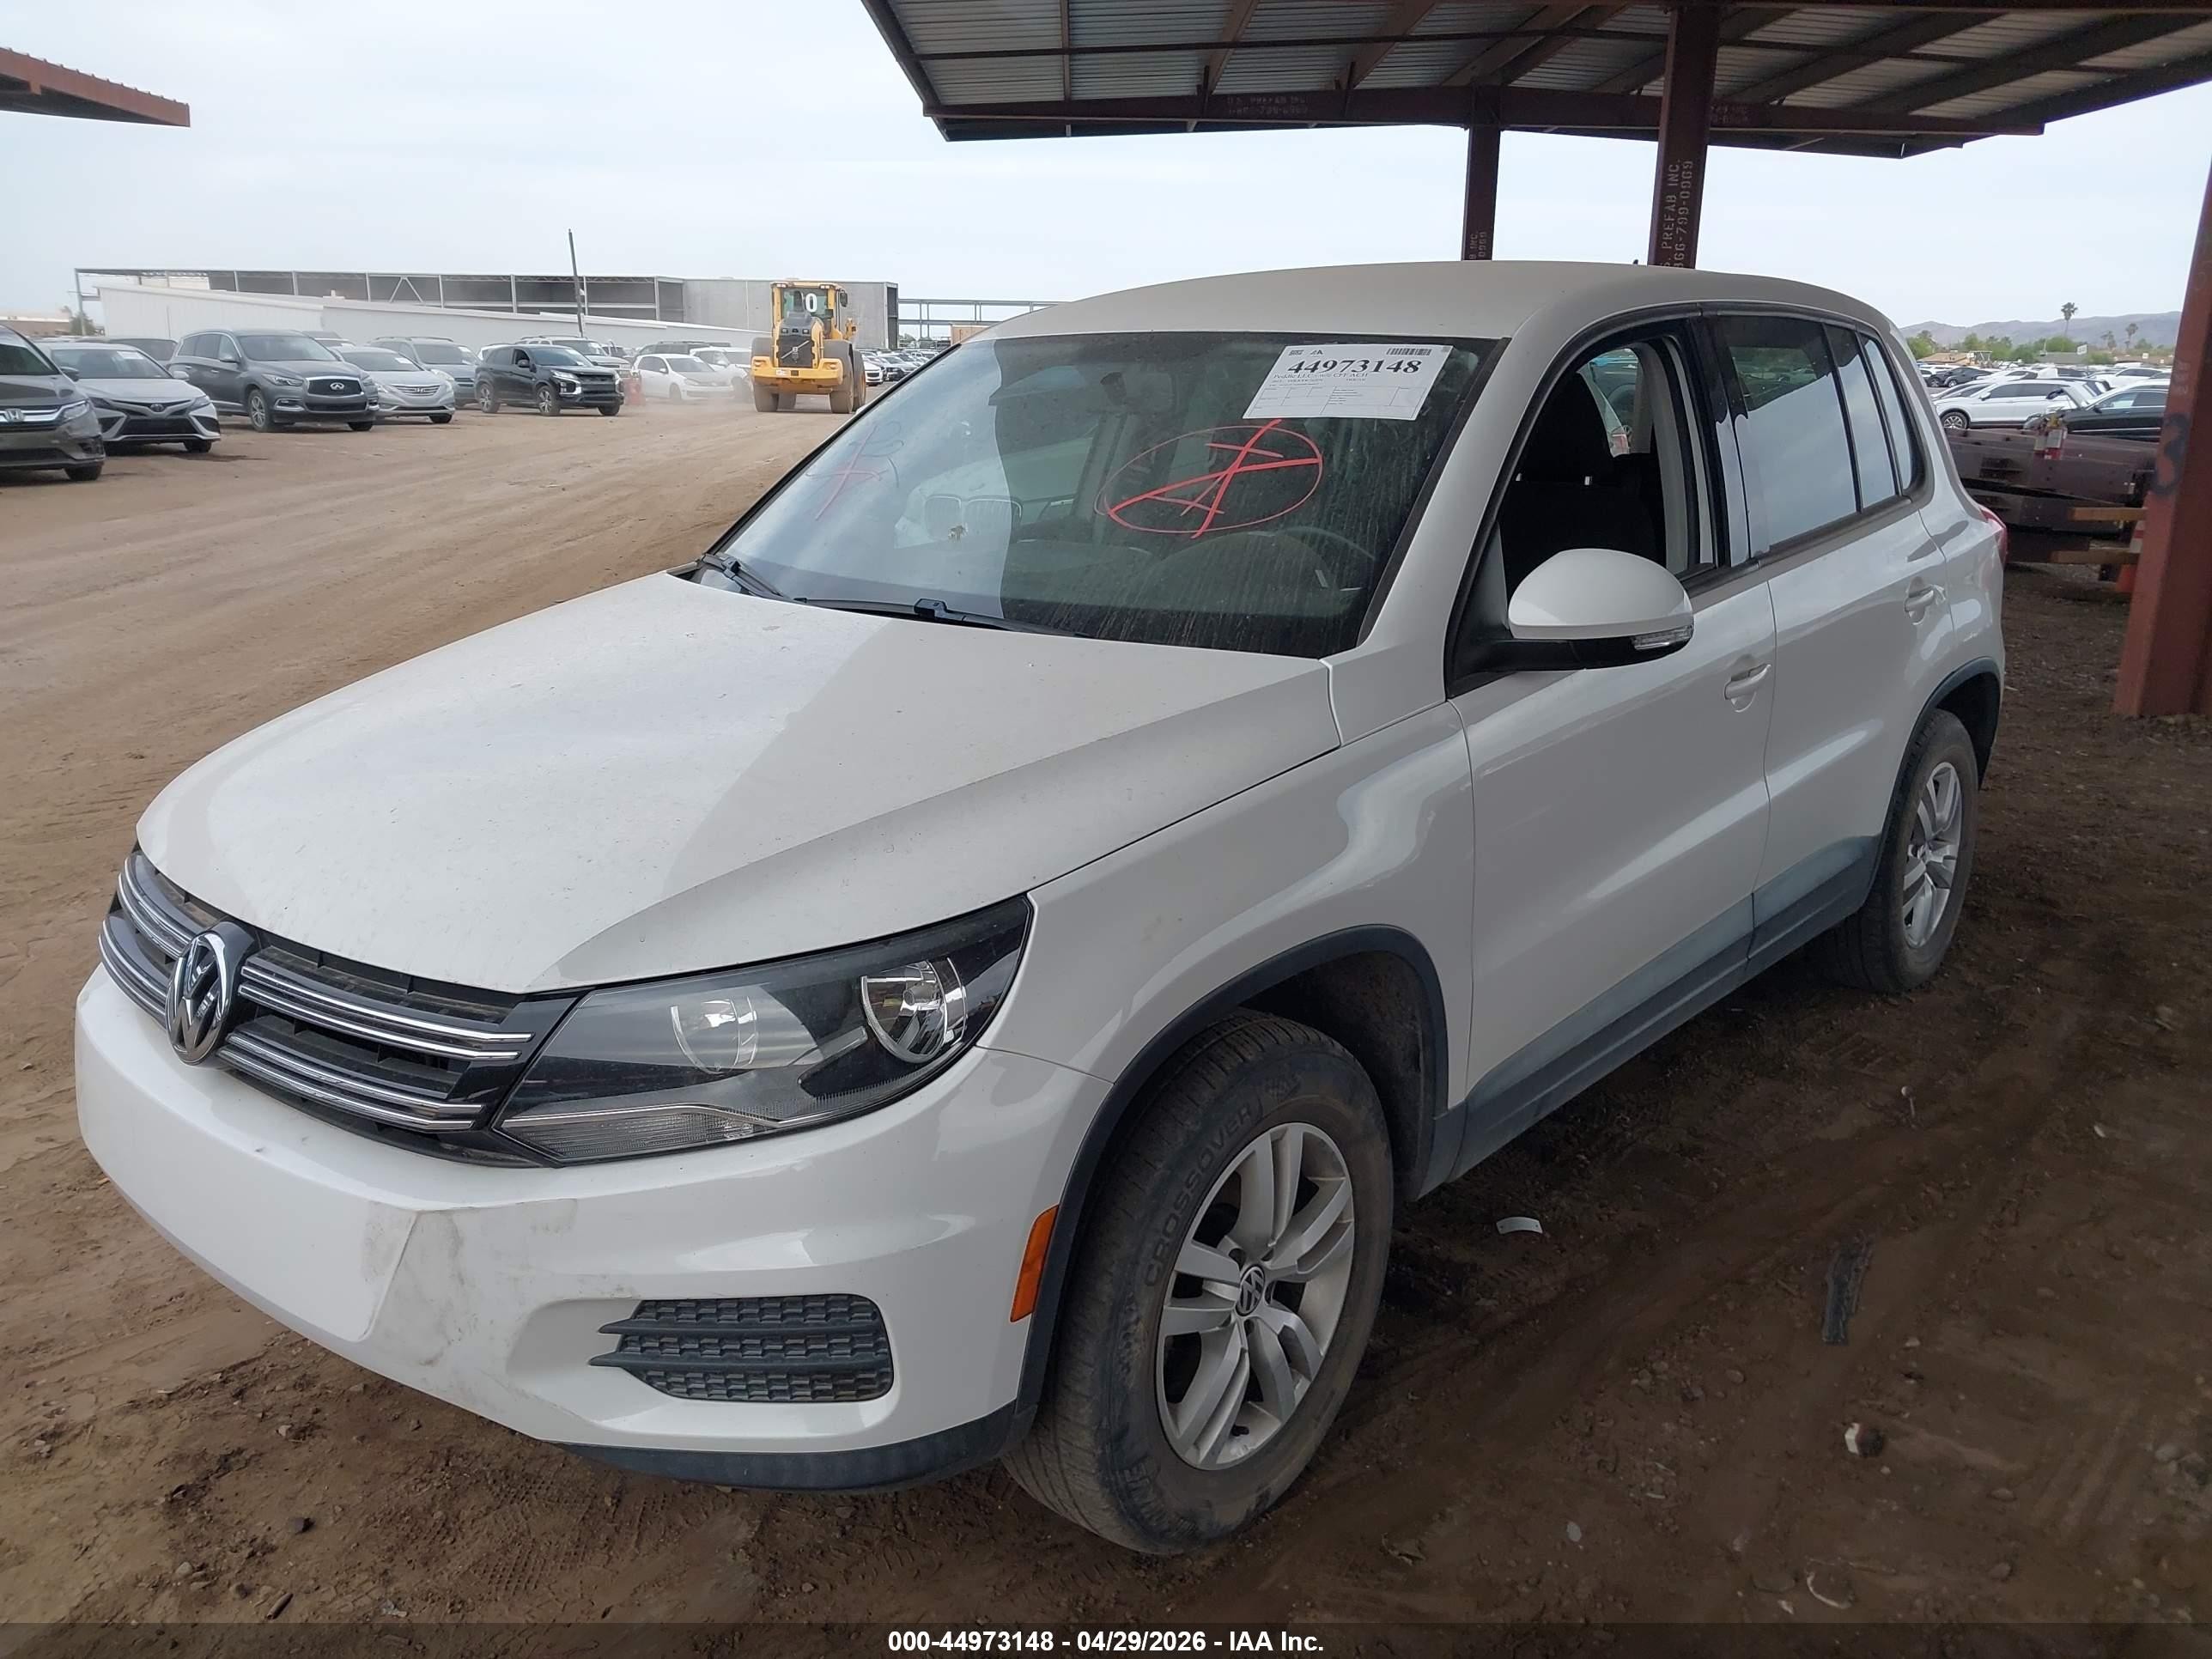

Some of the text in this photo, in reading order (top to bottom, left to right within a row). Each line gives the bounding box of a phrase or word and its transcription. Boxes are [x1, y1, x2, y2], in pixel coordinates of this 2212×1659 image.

[1661, 194, 1677, 249] PREFAB
[1288, 359, 1423, 374] 44973148
[1144, 1103, 1252, 1286] CROSSOVER
